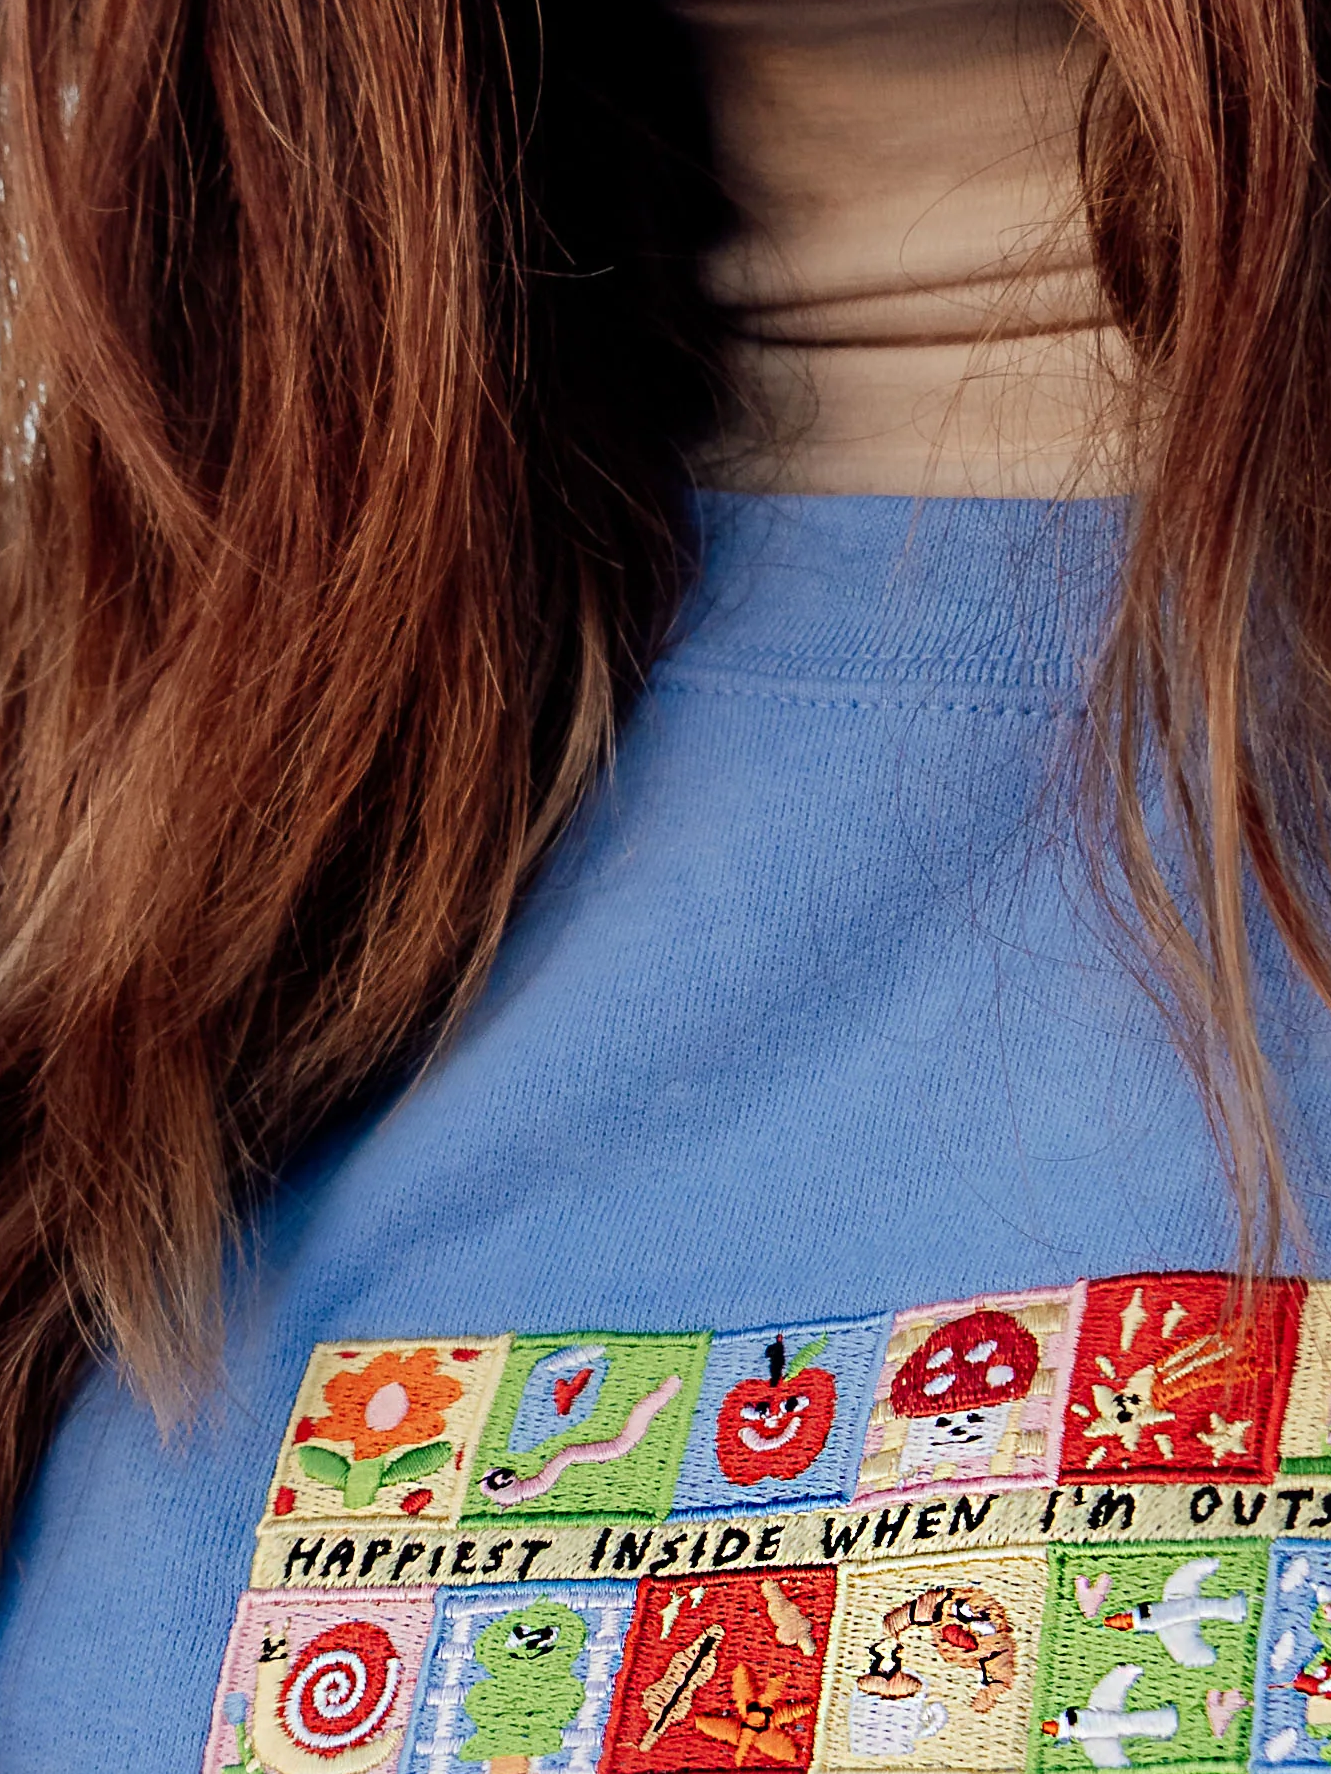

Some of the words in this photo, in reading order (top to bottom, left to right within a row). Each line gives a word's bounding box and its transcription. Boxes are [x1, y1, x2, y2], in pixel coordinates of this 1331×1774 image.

[283, 1536, 553, 1581] HAPPIEST
[589, 1525, 784, 1574] INSIDE
[820, 1493, 1000, 1558] WHEN
